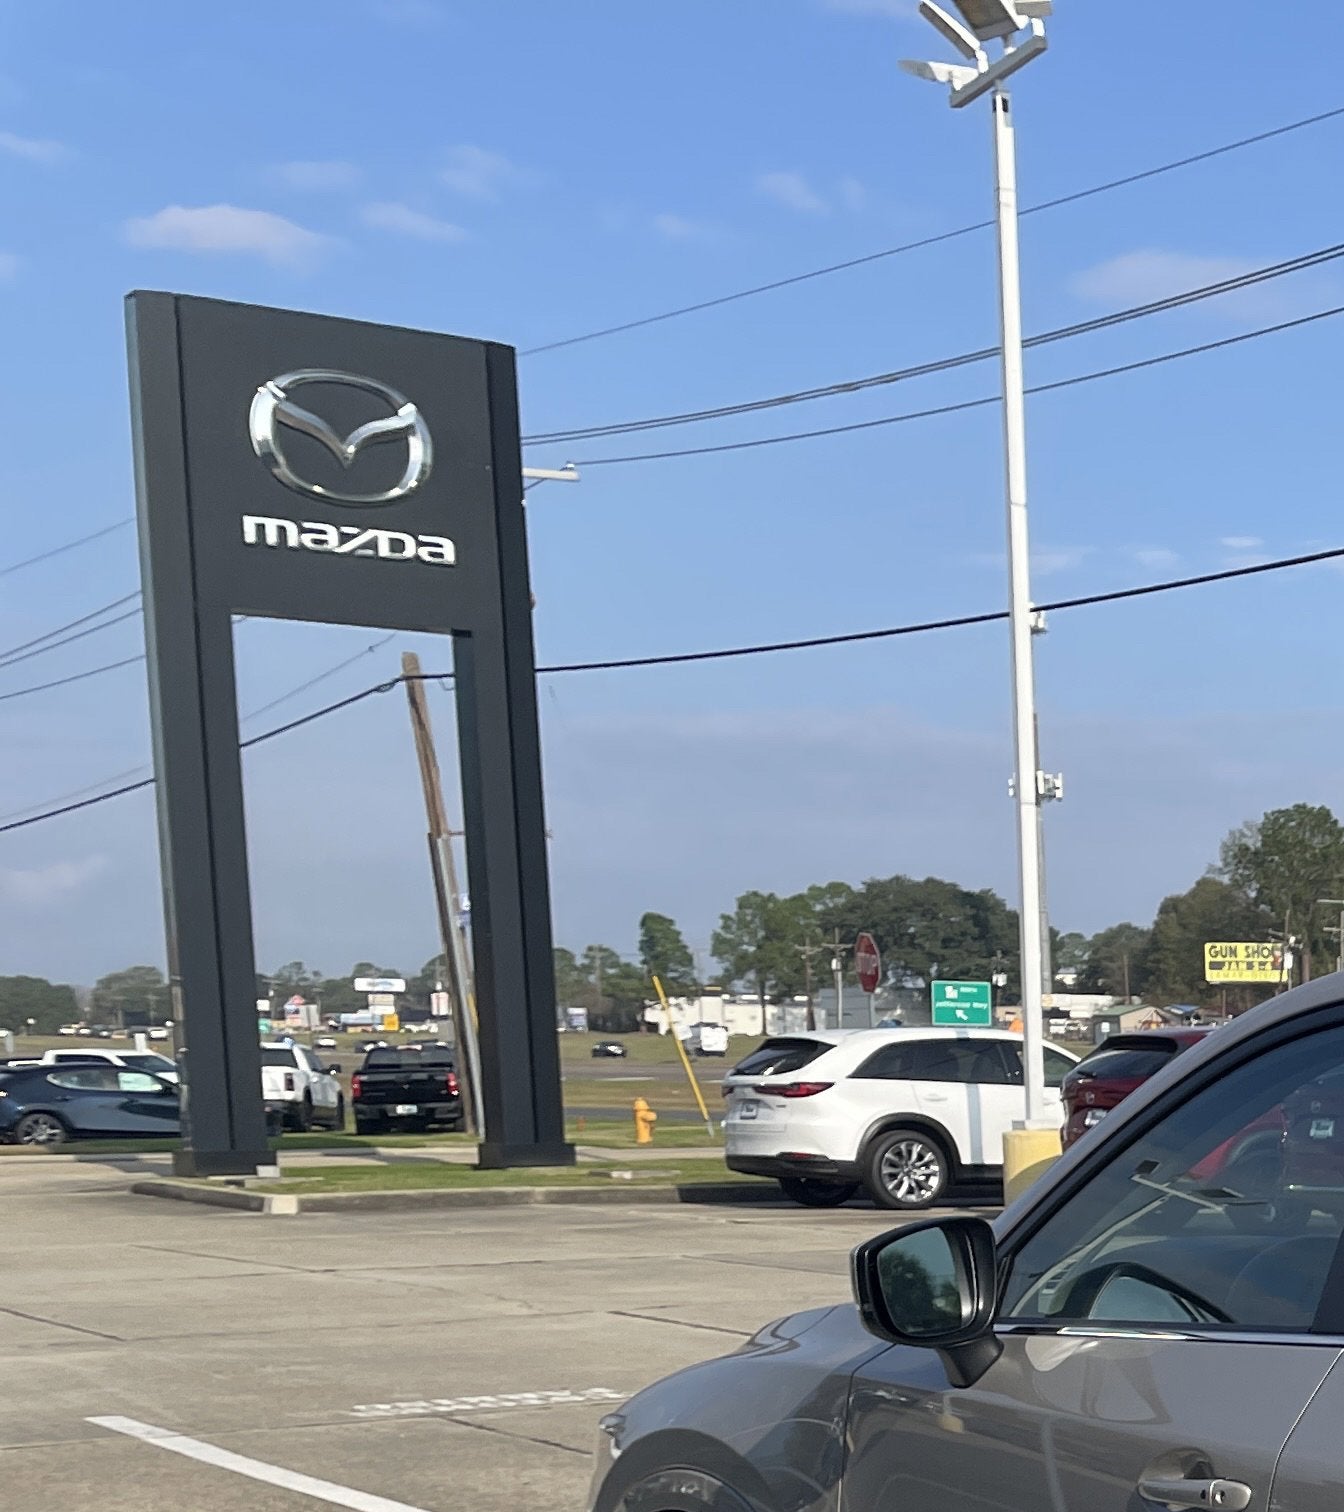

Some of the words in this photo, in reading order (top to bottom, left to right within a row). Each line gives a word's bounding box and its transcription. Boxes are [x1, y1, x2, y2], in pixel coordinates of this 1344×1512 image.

[242, 514, 457, 567] mazda
[1208, 945, 1238, 959] GUN
[1244, 945, 1275, 959] SHO
